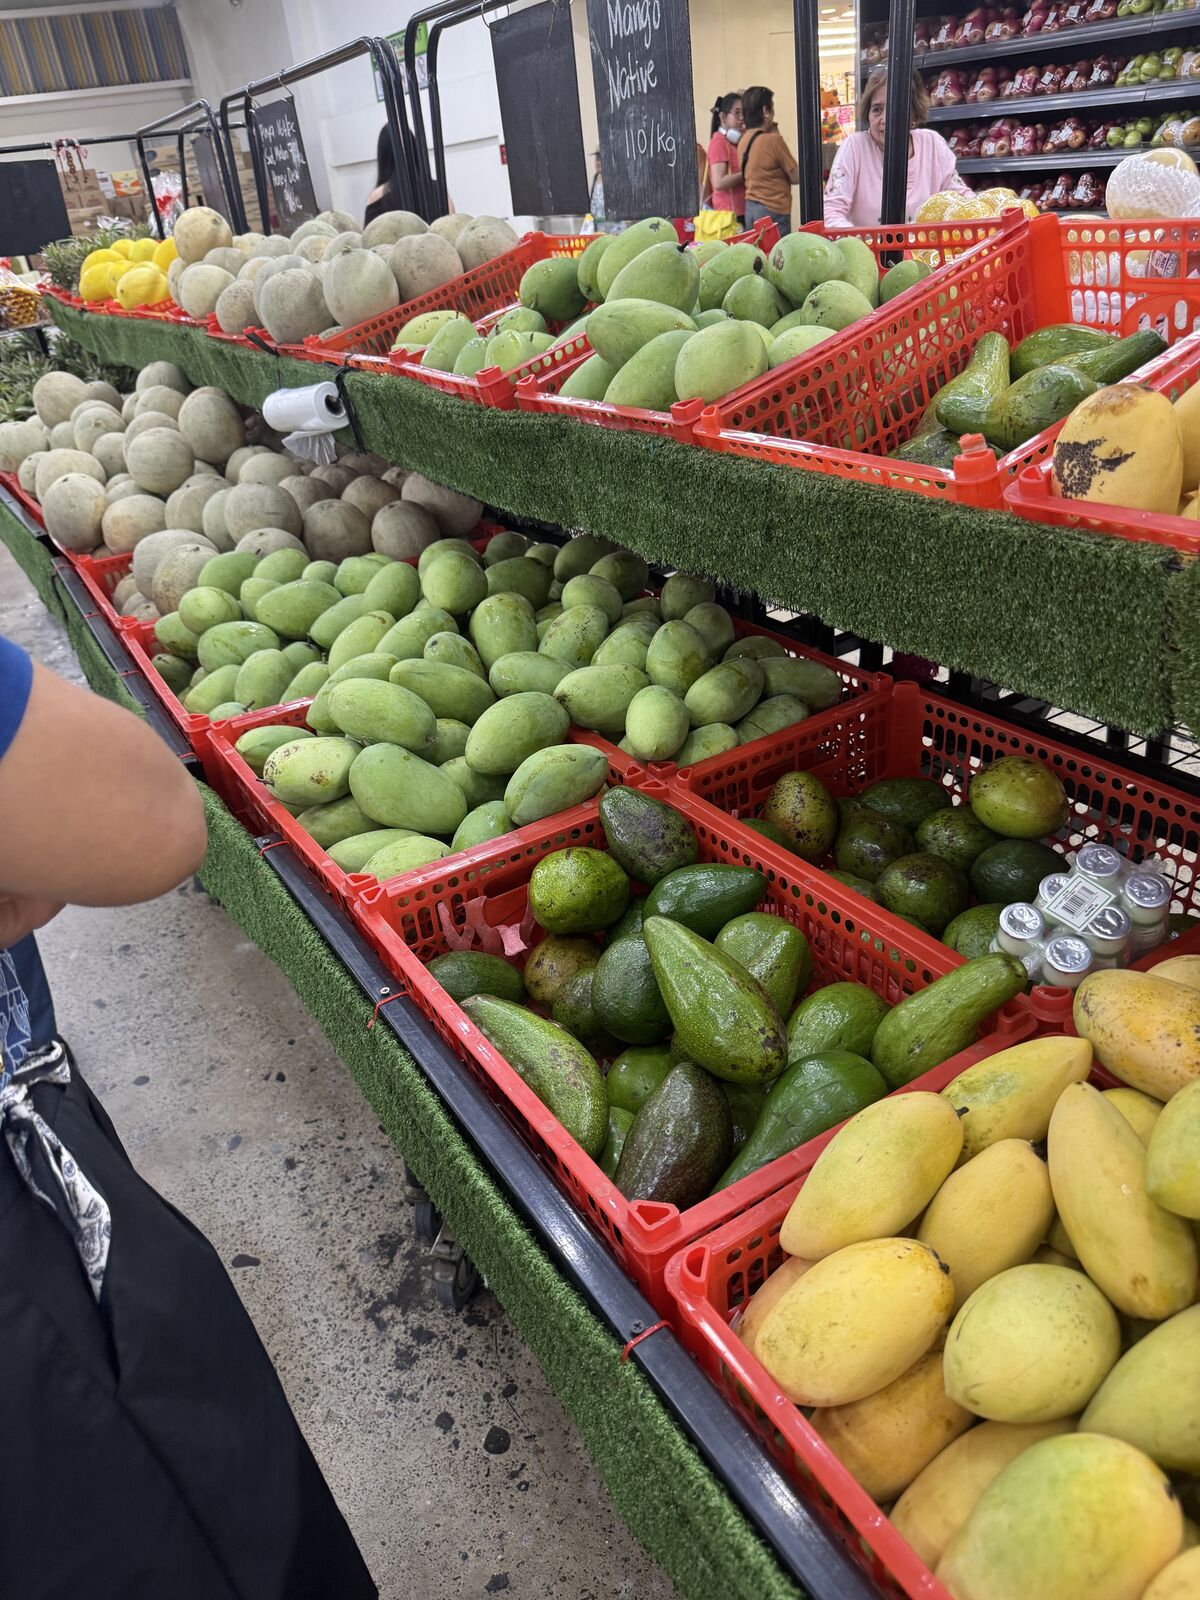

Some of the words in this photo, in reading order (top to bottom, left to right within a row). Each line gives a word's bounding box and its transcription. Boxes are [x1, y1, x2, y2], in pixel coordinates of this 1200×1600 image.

[607, 0, 660, 49] Mango
[607, 52, 657, 114] Native
[625, 118, 677, 167] 110/kg
